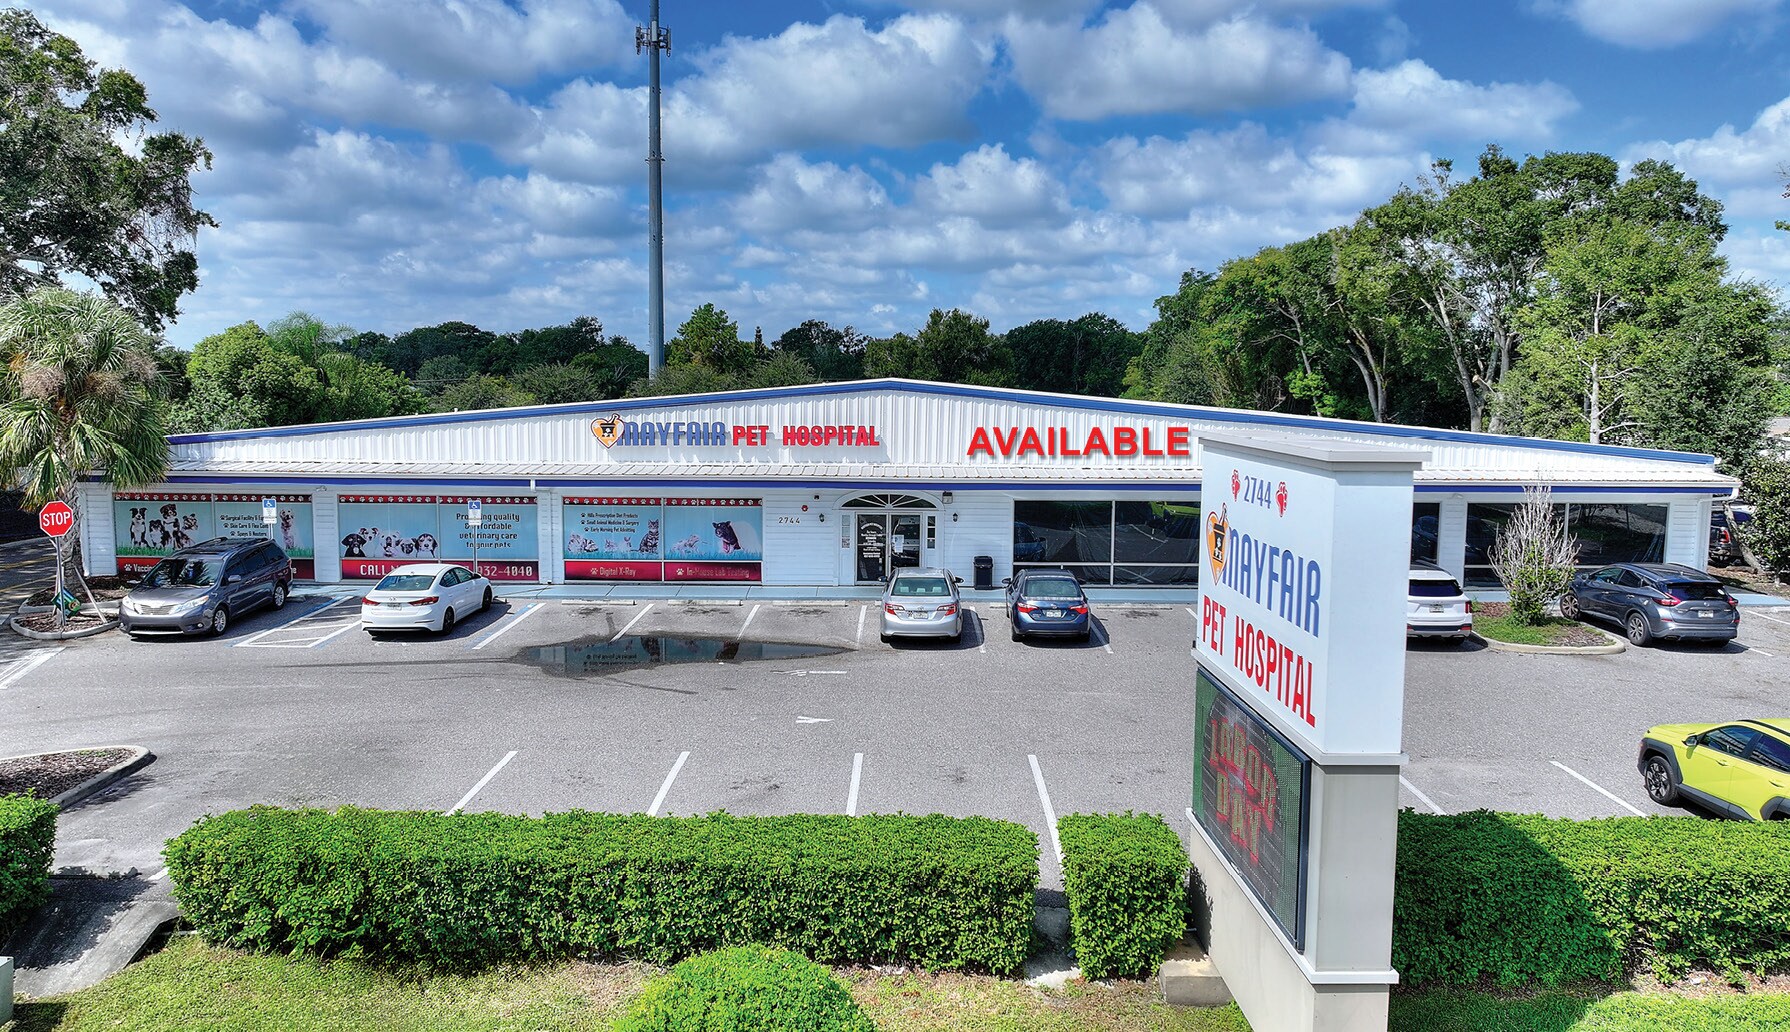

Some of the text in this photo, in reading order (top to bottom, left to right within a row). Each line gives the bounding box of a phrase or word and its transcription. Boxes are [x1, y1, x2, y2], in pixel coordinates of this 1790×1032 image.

[617, 421, 879, 446] MAYFAIR PET HOSPITAL
[1243, 475, 1272, 509] 2744
[42, 511, 71, 527] STOP
[456, 513, 492, 522] Proing
[493, 513, 520, 522] quality
[360, 565, 386, 576] CALL
[600, 567, 636, 577] Digital X-Ray
[1222, 526, 1321, 638] MAYFAIR
[1202, 594, 1316, 728] PET HOSPITAL
[1210, 716, 1278, 833] LABOR
[1216, 767, 1262, 865] DAY
